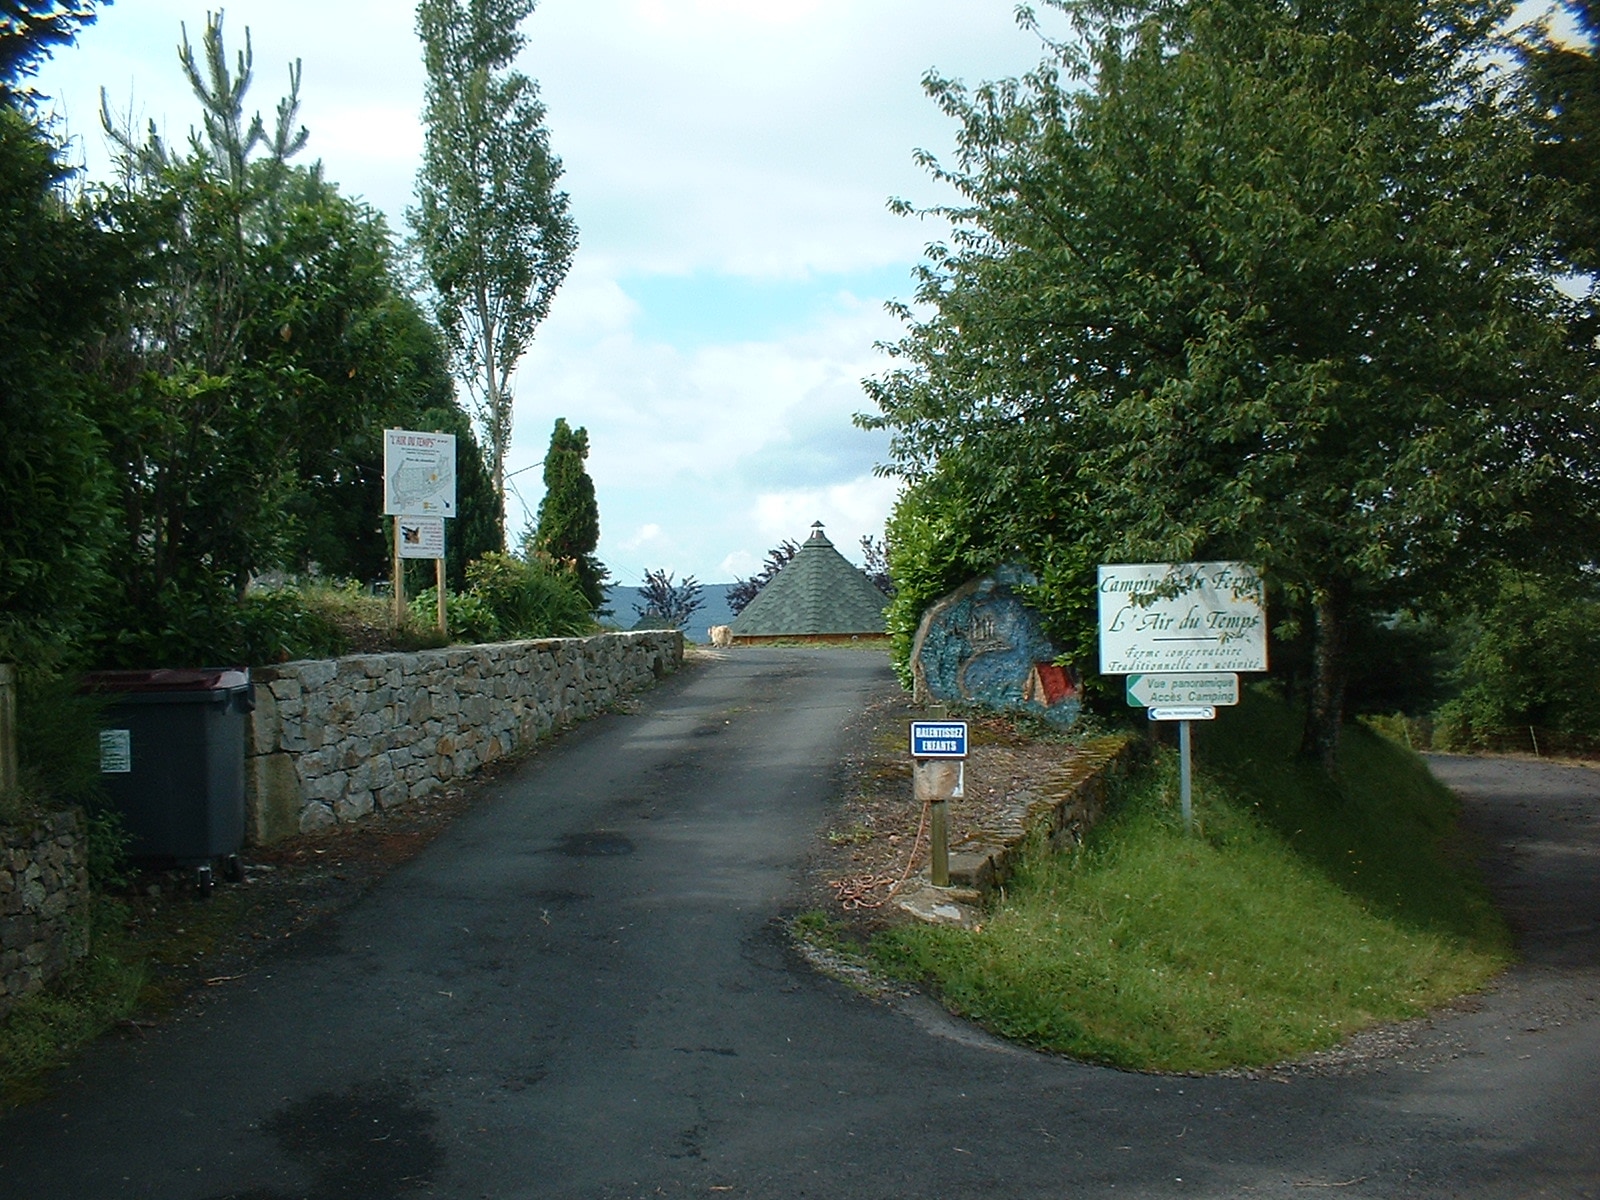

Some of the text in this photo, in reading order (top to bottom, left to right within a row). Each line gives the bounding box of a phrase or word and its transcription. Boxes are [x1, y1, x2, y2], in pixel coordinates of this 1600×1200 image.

[1179, 605, 1200, 629] du
[1207, 611, 1260, 635] Temps
[1125, 644, 1242, 659] Ferme conservatoire
[1108, 657, 1192, 671] Traditionnelle
[1196, 662, 1209, 670] en
[1147, 677, 1234, 690] Vue panoramique
[1150, 691, 1235, 704] Accès Camping
[915, 727, 964, 738] RALENTISSEZ
[922, 740, 957, 752] ENFANTS
